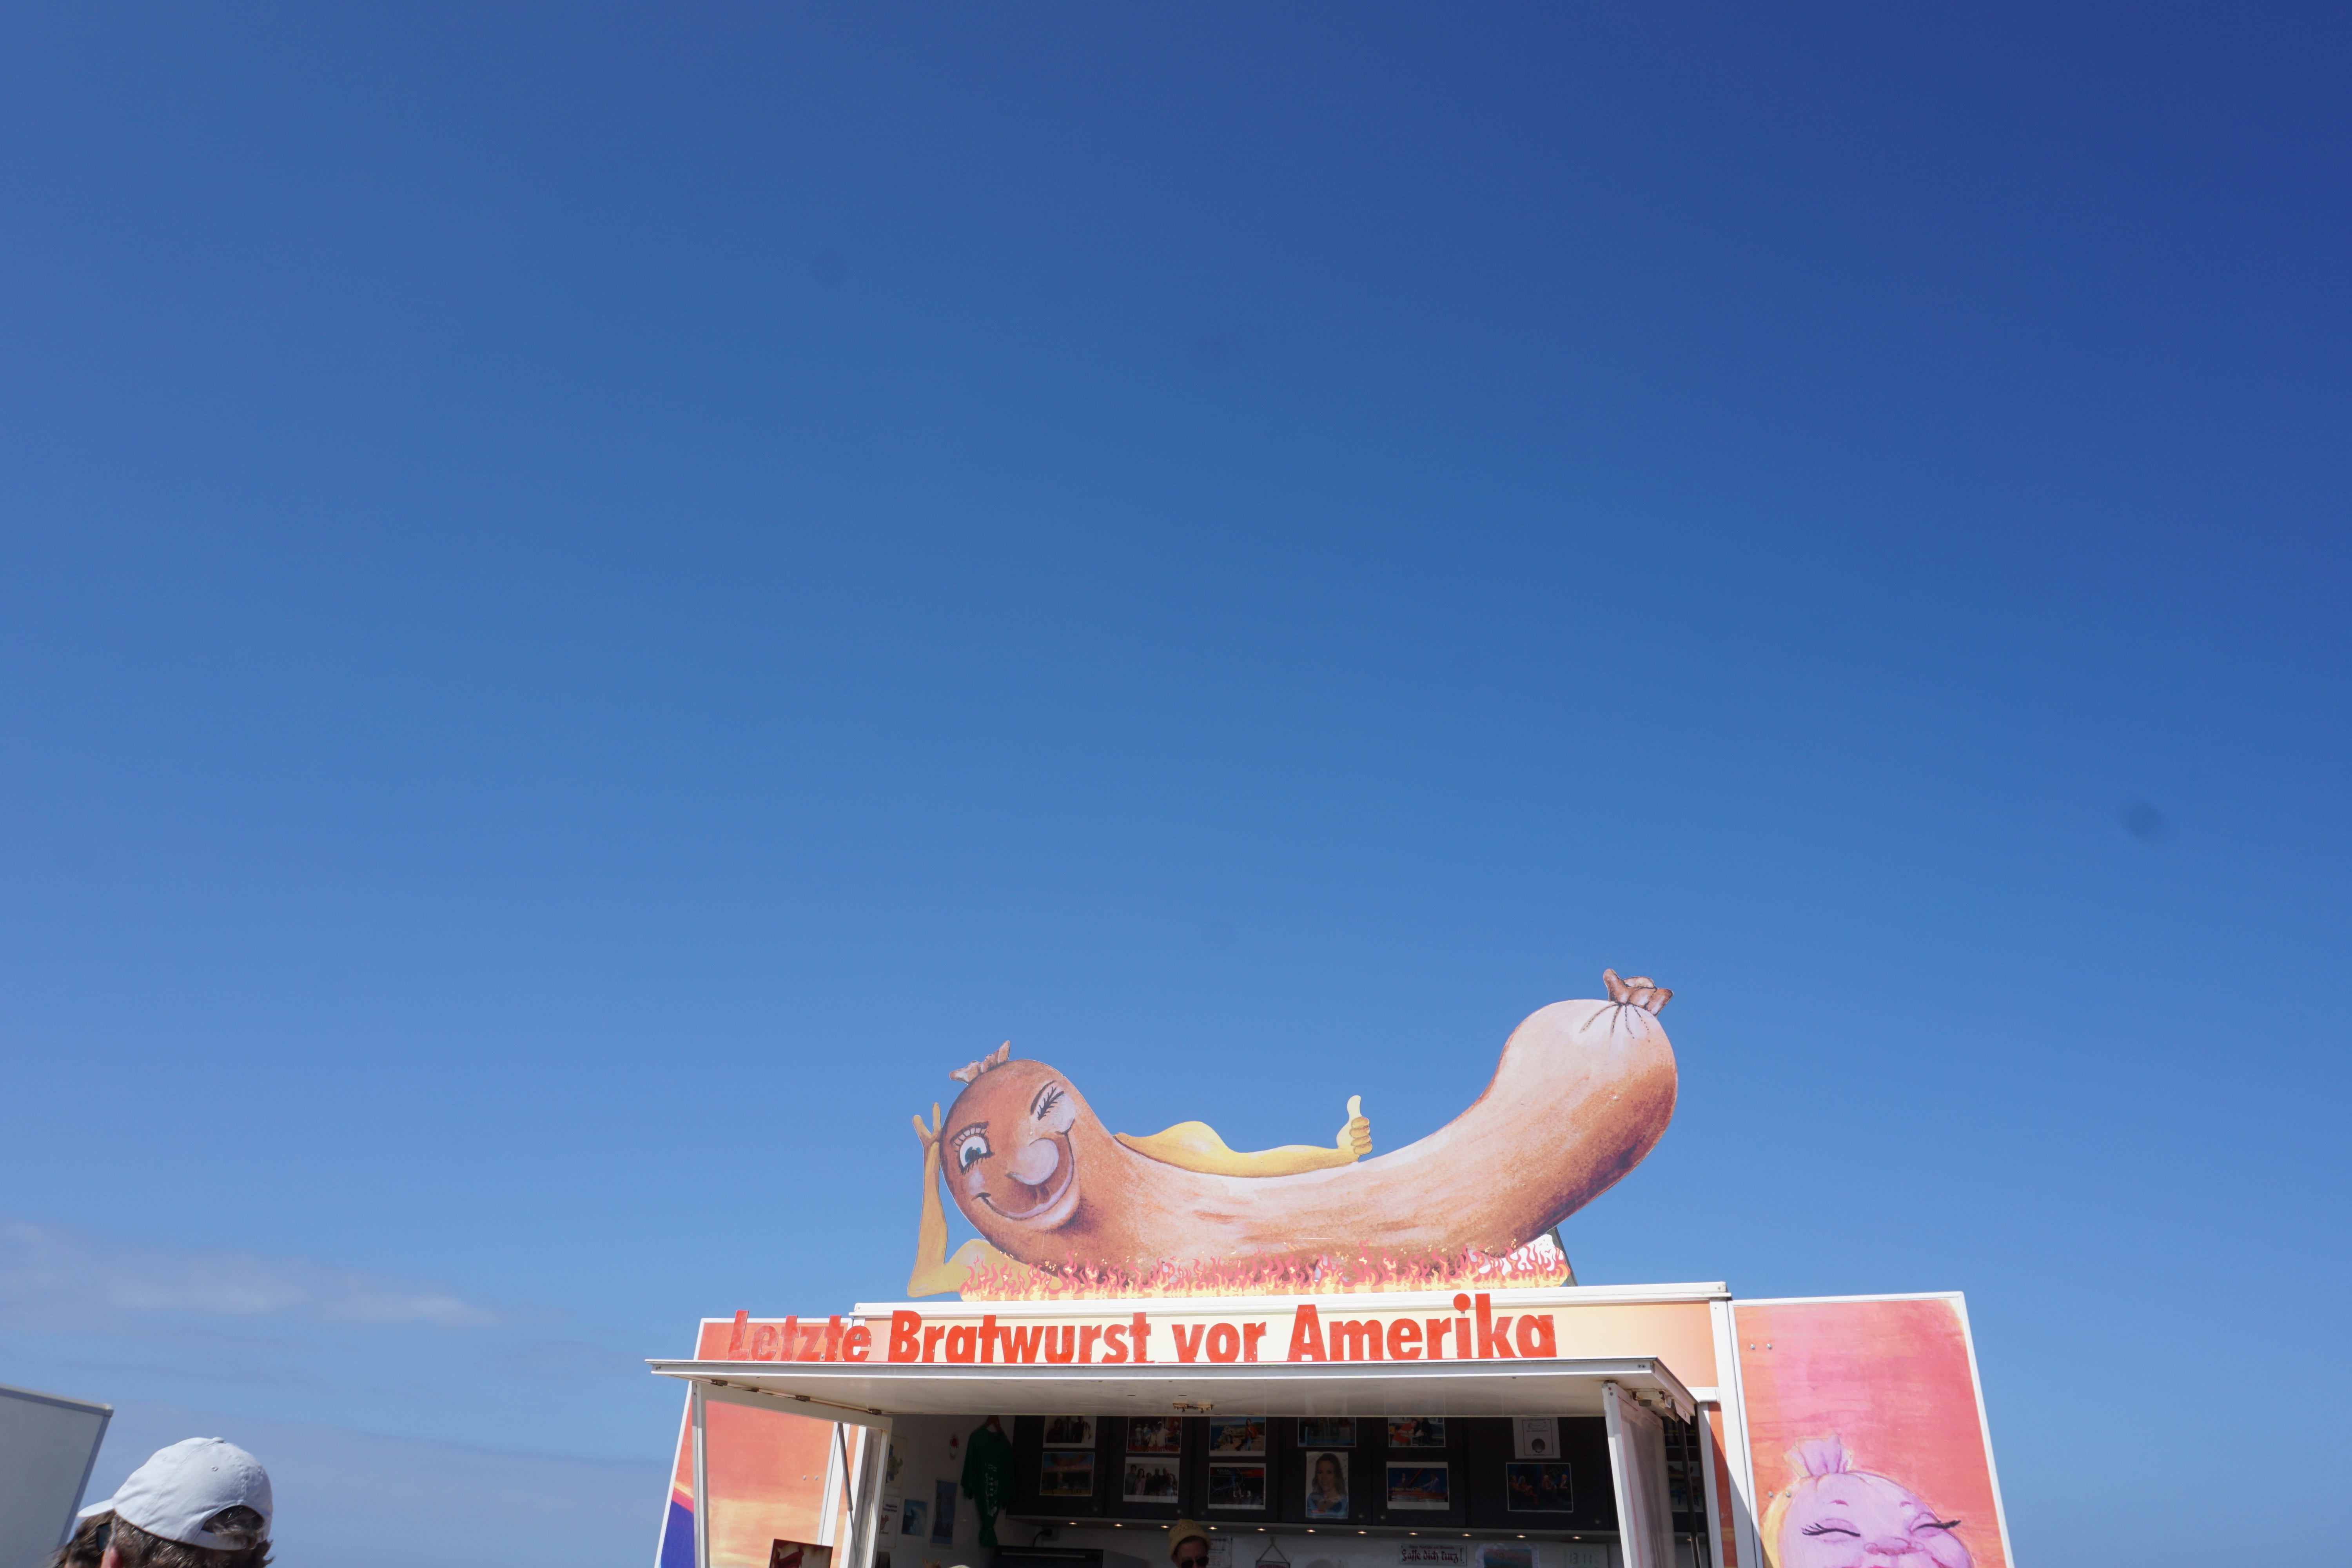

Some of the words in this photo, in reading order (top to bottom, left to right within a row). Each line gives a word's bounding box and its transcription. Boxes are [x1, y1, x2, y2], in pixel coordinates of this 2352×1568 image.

[727, 1310, 871, 1361] Letzte
[888, 1310, 1151, 1363] Bratwurst
[1172, 1321, 1266, 1363] vor
[1288, 1293, 1557, 1362] Amerika
